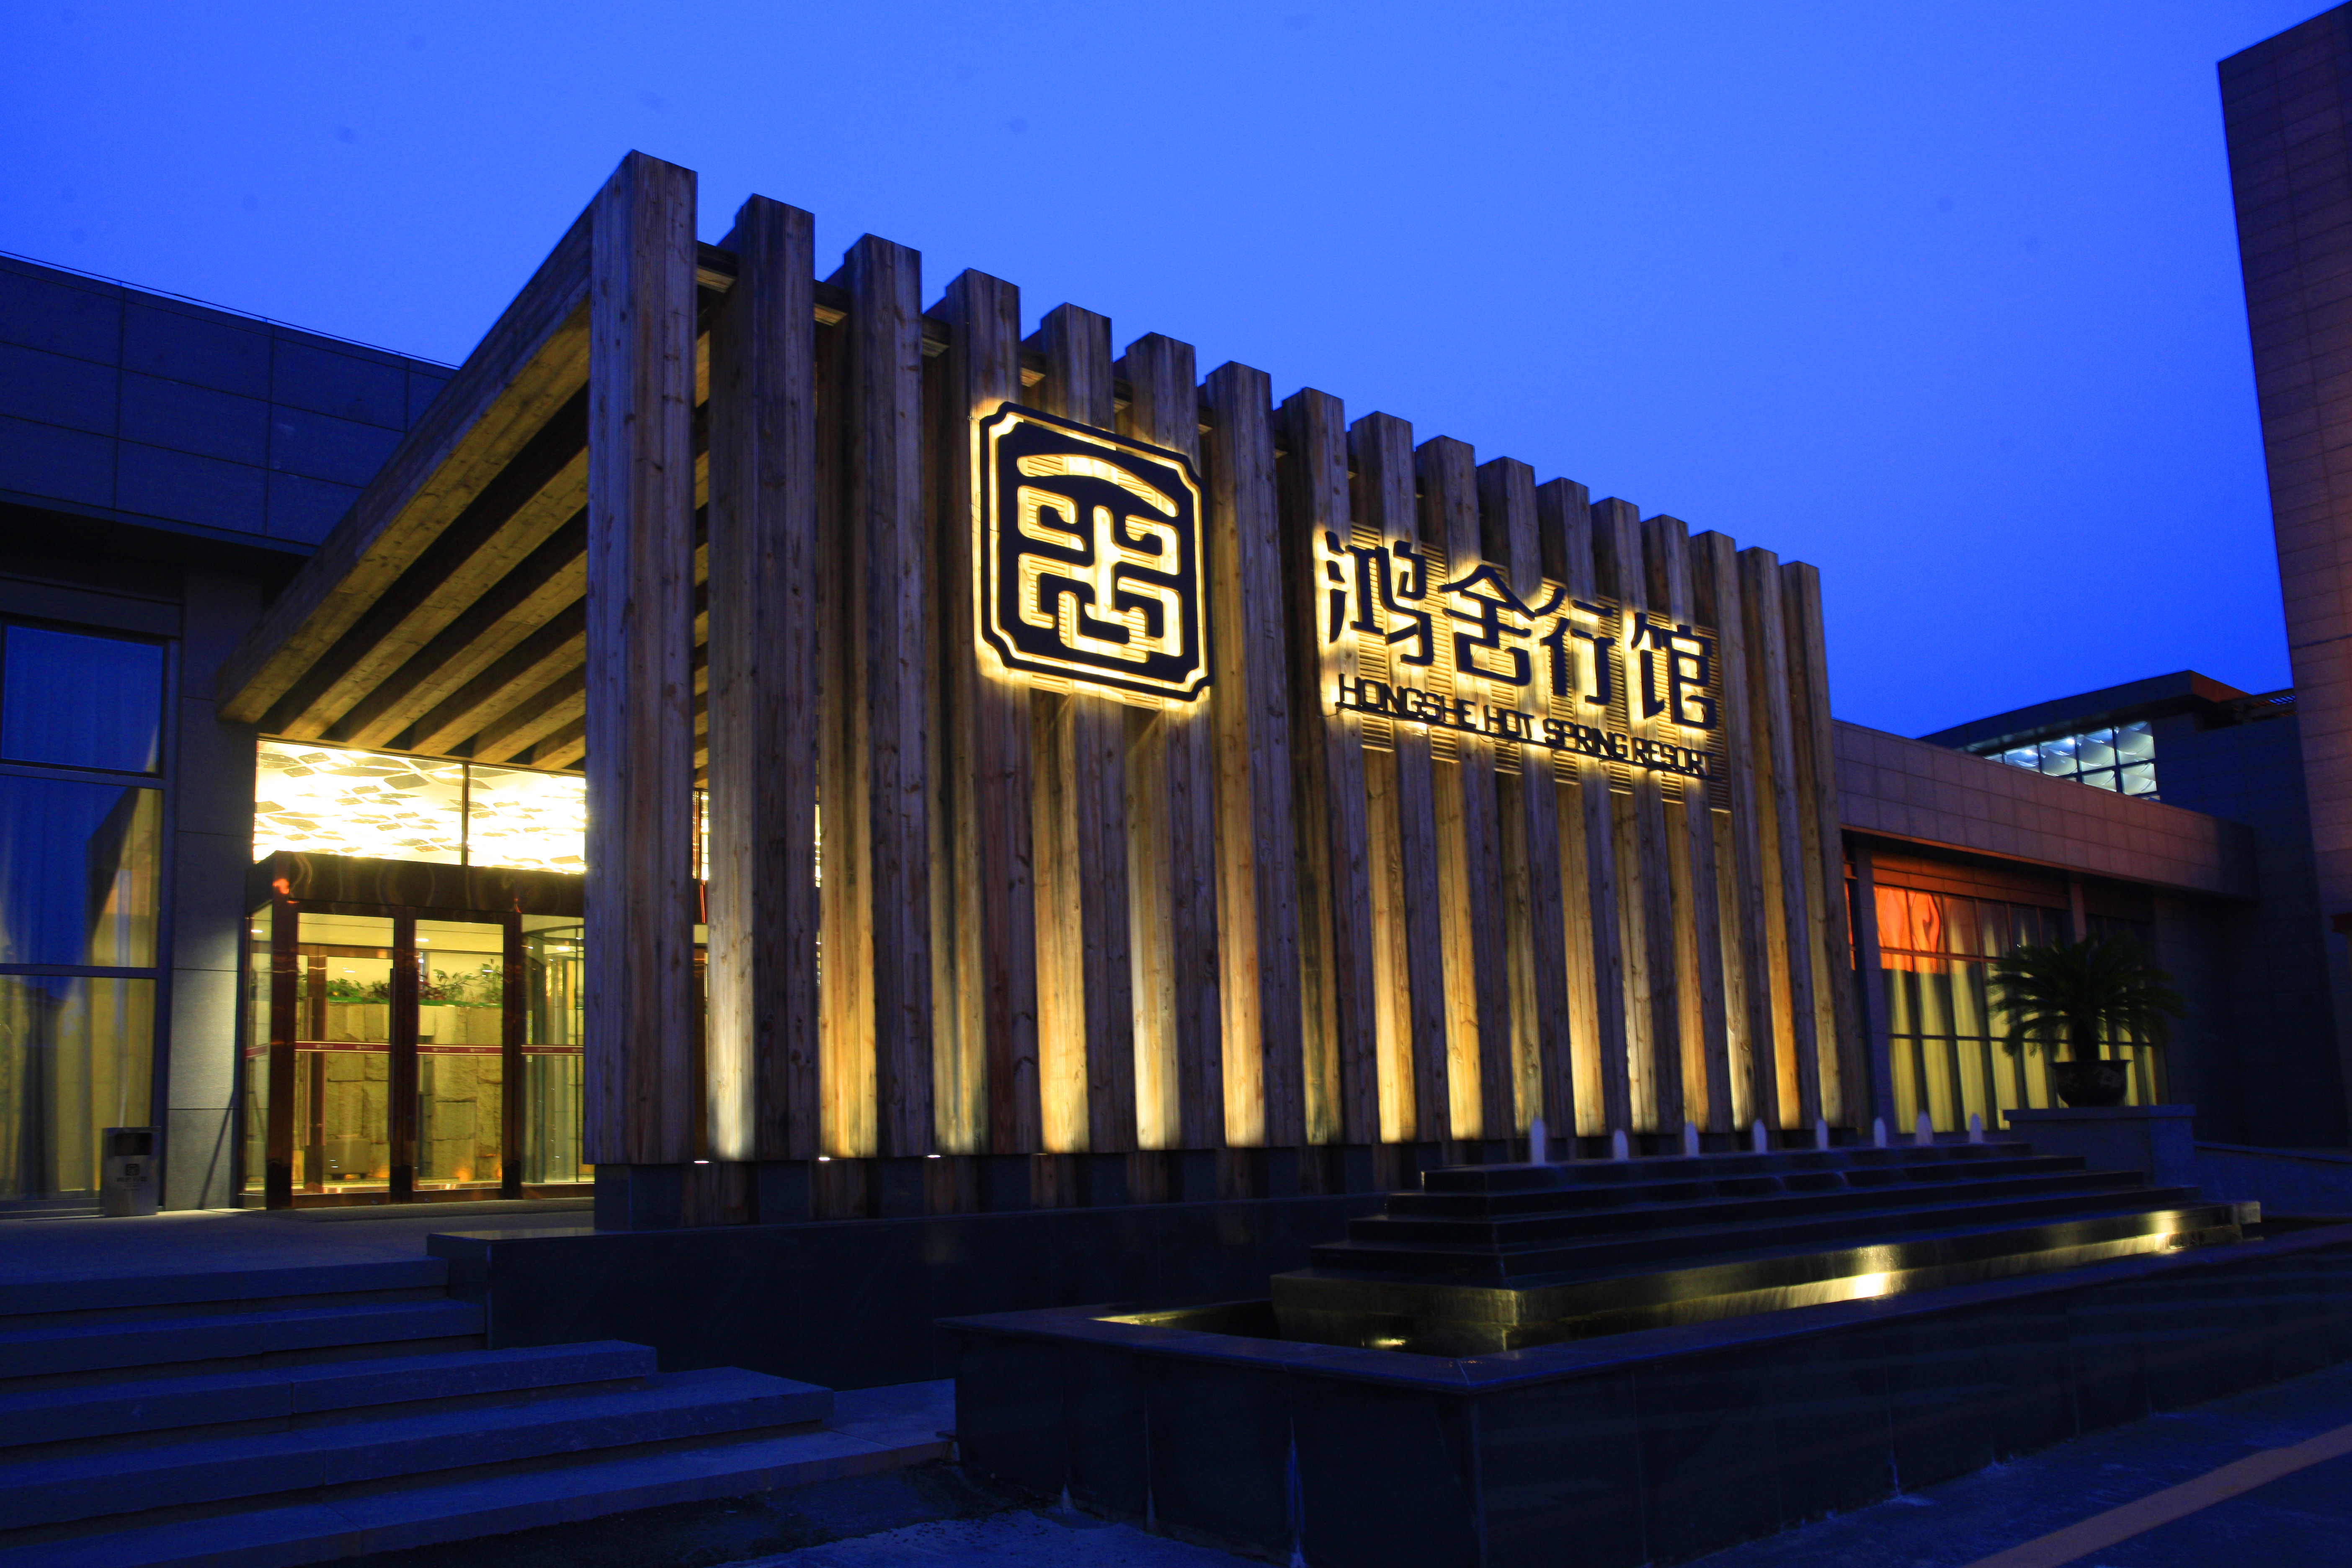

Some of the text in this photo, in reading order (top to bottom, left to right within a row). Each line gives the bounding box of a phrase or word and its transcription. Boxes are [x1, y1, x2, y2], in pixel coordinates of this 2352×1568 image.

[1326, 530, 1718, 730] 鸿舍行馆
[1338, 673, 1715, 776] HONGSHE HOT SPRING RESORT
